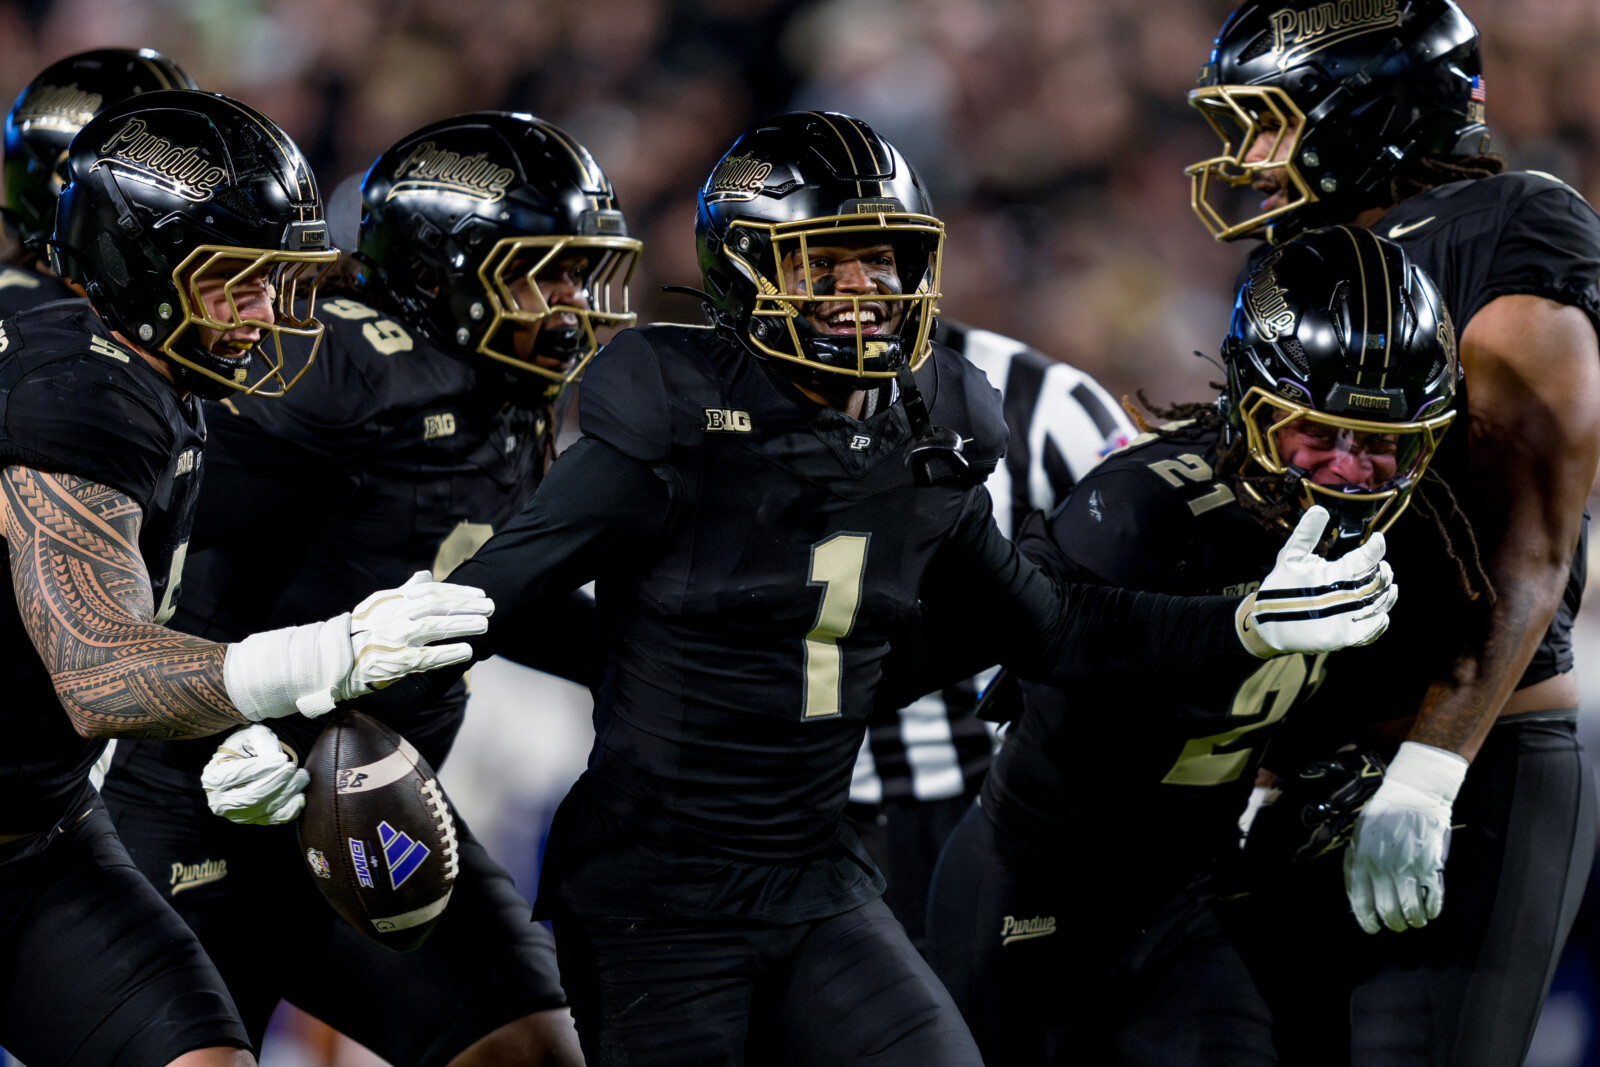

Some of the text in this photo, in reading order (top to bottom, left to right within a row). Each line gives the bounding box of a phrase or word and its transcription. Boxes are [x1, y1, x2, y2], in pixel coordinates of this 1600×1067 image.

[1268, 0, 1400, 68] Purdue
[90, 117, 224, 202] Purdue
[386, 140, 515, 203] Purdue
[322, 299, 413, 355] 99
[863, 341, 888, 358] P
[1349, 393, 1390, 409] PURDUE
[850, 435, 871, 450] P
[1147, 453, 1237, 517] 21
[802, 531, 872, 720] 1
[170, 858, 228, 895] Purdue
[348, 837, 374, 888] DIME
[1000, 915, 1057, 946] Purdue
